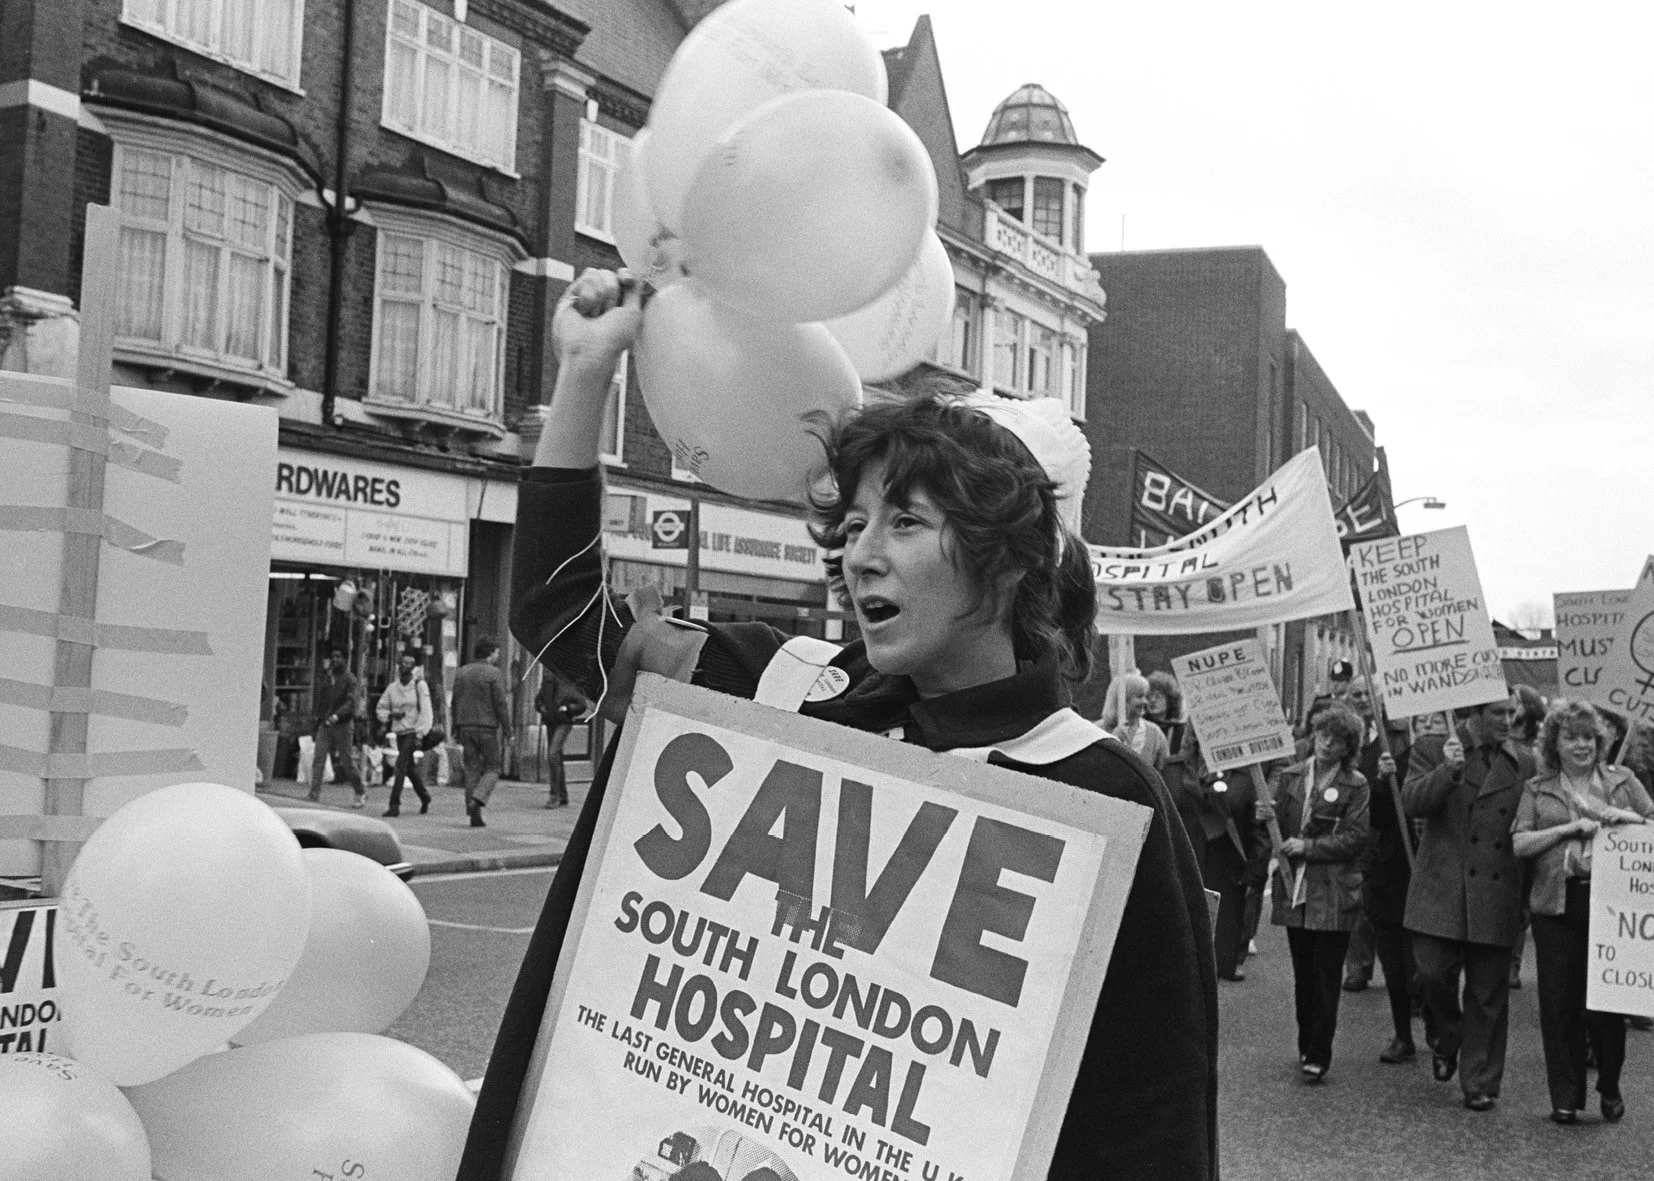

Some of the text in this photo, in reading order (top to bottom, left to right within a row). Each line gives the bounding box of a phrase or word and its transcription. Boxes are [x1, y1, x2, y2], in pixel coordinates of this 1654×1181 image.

[1359, 535, 1428, 568] KEEP
[1108, 561, 1293, 611] STAY OPEN
[1361, 554, 1440, 586] THE SOUTH
[1368, 577, 1438, 603] LONDON
[1370, 589, 1454, 618] HOSPITAL
[1372, 614, 1408, 634] FOR
[1392, 615, 1464, 647] OPEN
[1188, 648, 1246, 672] NUPE
[1384, 668, 1408, 685] NO
[633, 732, 1066, 1008] SAVE
[1620, 855, 1654, 872] LON
[771, 886, 860, 960] THE
[118, 941, 195, 992] South
[1596, 944, 1616, 961] TO
[614, 891, 1000, 1079] SOUTH LONDON
[630, 954, 931, 1147] HOSPITAL
[577, 1005, 606, 1034] THE
[612, 1022, 654, 1055] LAST
[656, 1041, 735, 1092] GENERAL
[742, 1081, 833, 1138] HOSPITAL
[841, 1124, 866, 1151] IN
[876, 1139, 913, 1173] THE
[624, 1053, 661, 1090] RUN
[666, 1072, 693, 1102] BY
[699, 1084, 773, 1135] WOMEN
[778, 1122, 816, 1156] FOR
